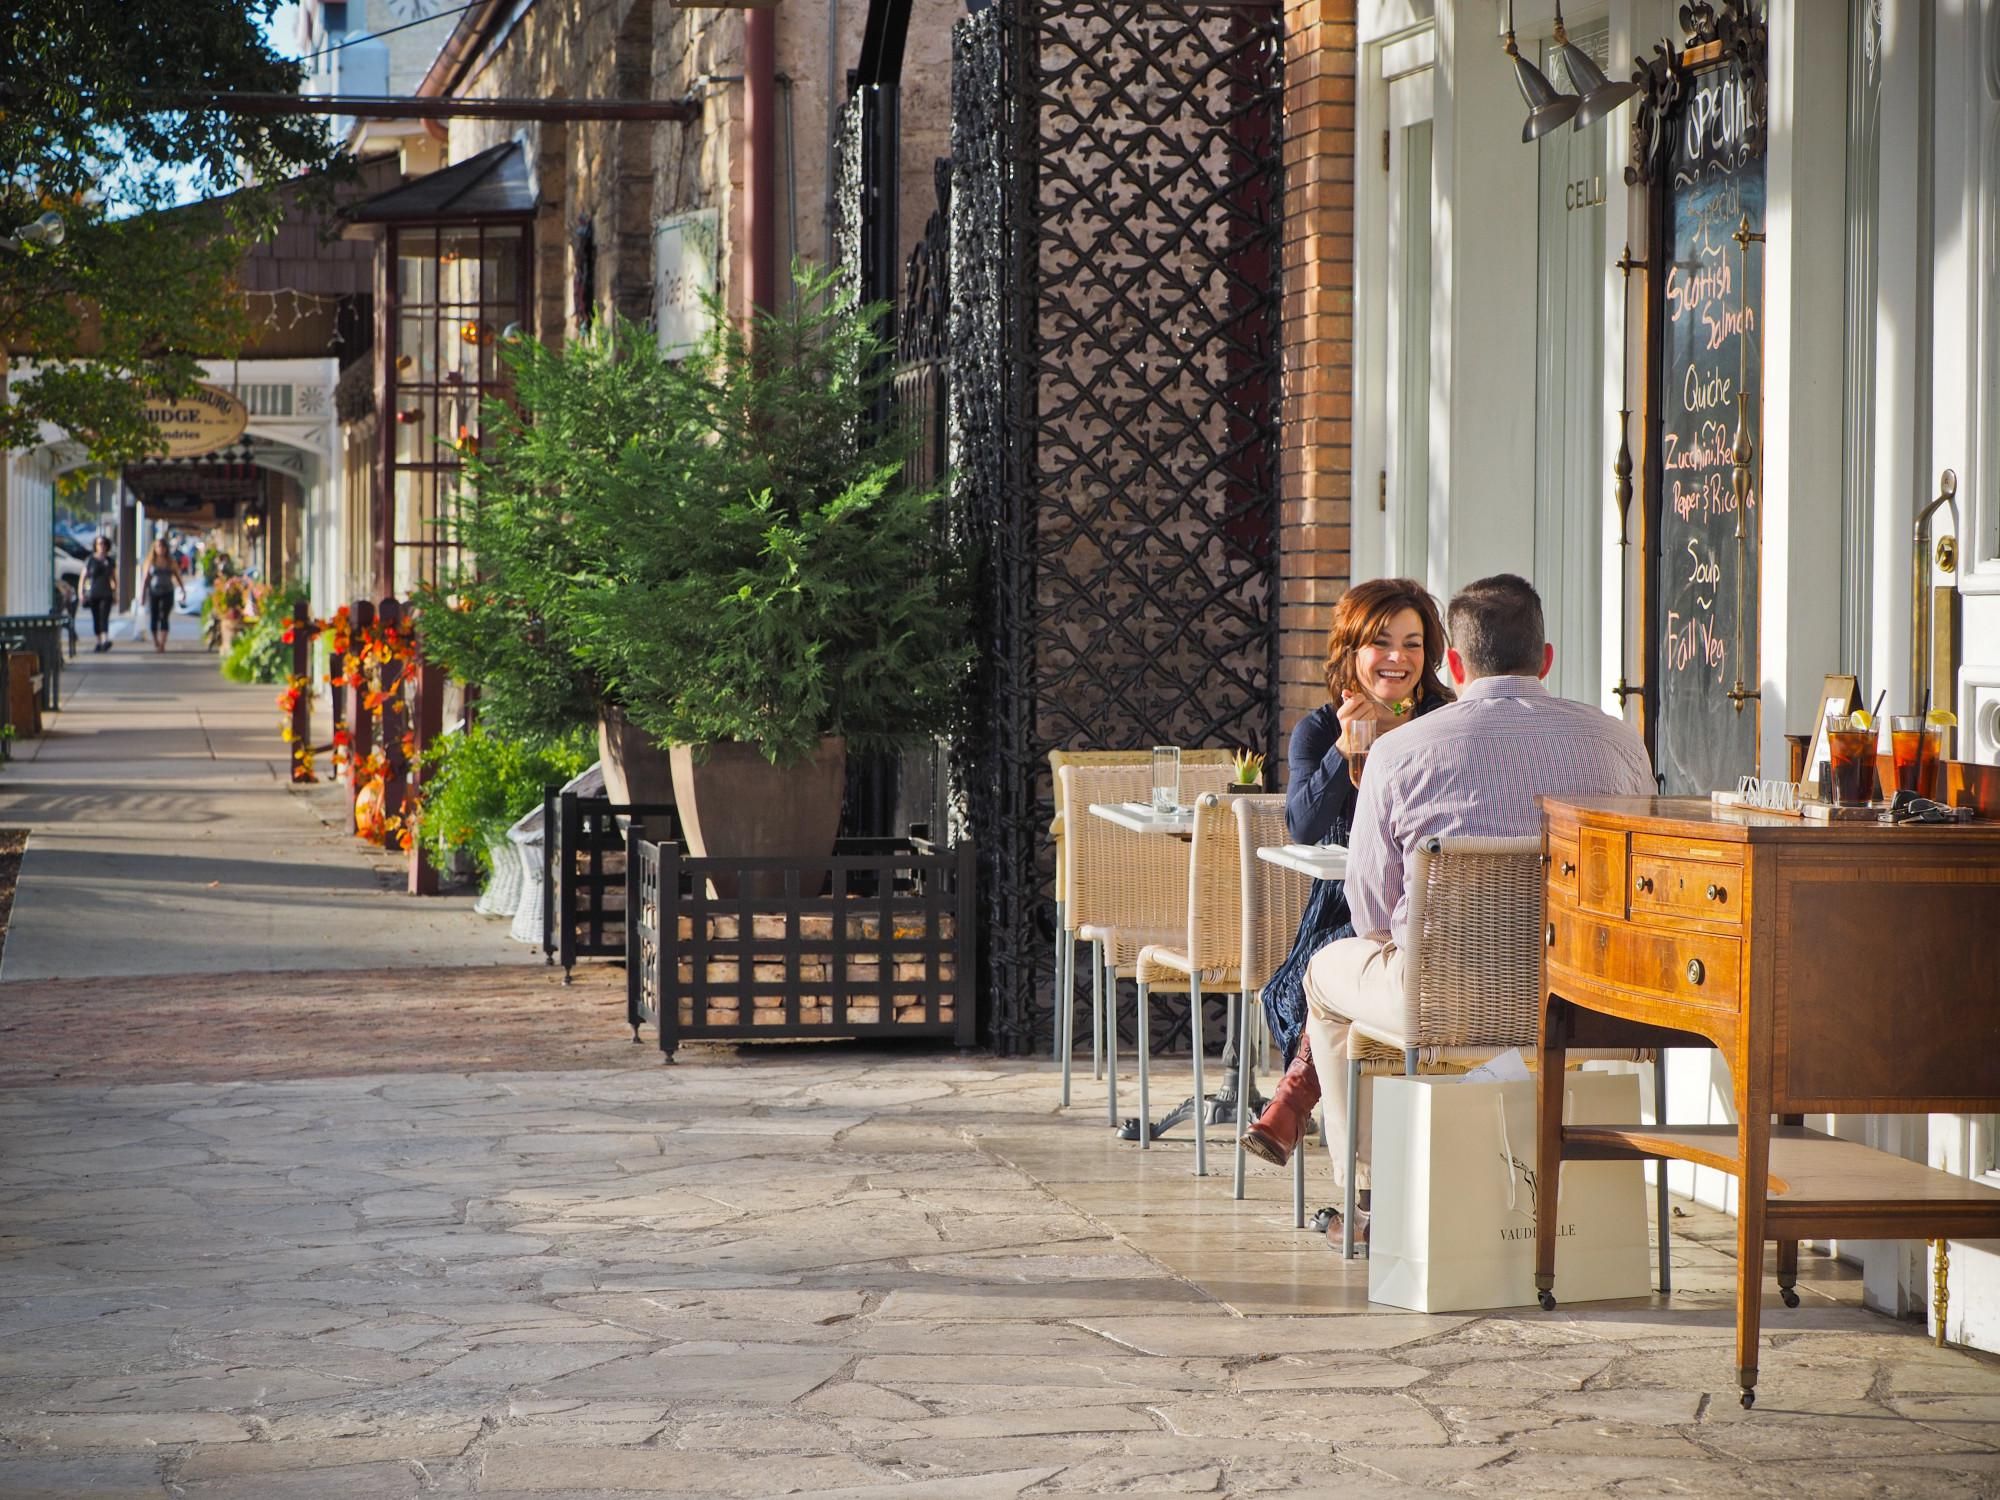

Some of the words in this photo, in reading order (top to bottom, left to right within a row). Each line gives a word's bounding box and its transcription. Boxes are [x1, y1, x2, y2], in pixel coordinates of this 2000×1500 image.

[1666, 245, 1732, 322] Scottish
[1684, 363, 1731, 413] Quiche
[1672, 480, 1701, 523] Pepper
[1687, 538, 1721, 594] Soup
[1668, 609, 1696, 671] Fall
[1702, 613, 1725, 684] Veg
